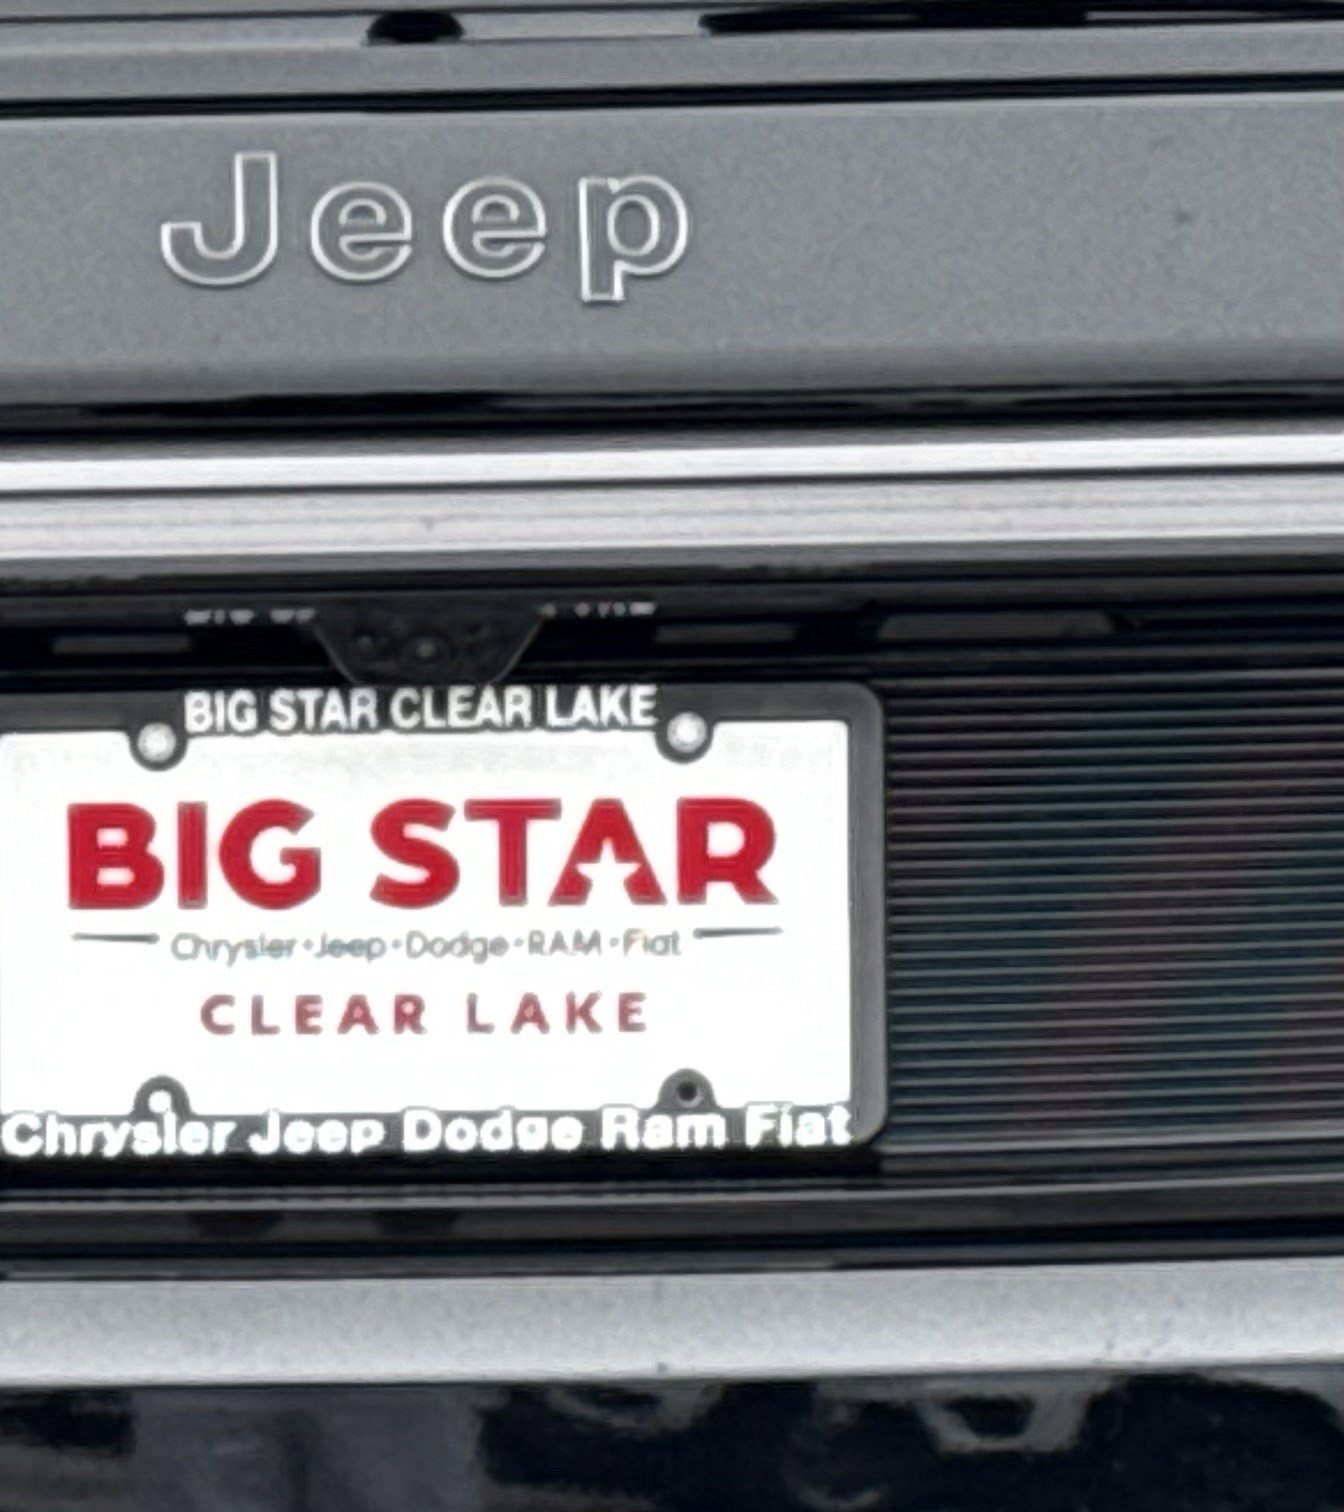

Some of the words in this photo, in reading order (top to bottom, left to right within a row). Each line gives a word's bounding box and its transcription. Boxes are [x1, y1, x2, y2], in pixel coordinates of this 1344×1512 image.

[160, 151, 689, 302] Jeep
[183, 688, 258, 734] BIG
[269, 686, 378, 731] STAR
[389, 684, 533, 730] CLEAR
[545, 683, 659, 728] LAKE
[66, 799, 322, 912] BIG
[368, 796, 779, 909] STAR
[169, 930, 298, 968] Chrysler
[314, 931, 388, 964] Jeep
[406, 930, 510, 965] Dodge
[527, 928, 603, 957] RAM
[622, 927, 682, 957] Fiat
[199, 992, 428, 1036] CLEAR
[465, 990, 648, 1035] LAKE
[0, 1111, 238, 1158] Chrysler
[248, 1108, 386, 1156] Jeep
[402, 1106, 585, 1153] Dodge
[600, 1104, 727, 1151] Ram
[744, 1102, 853, 1149] Fiat
